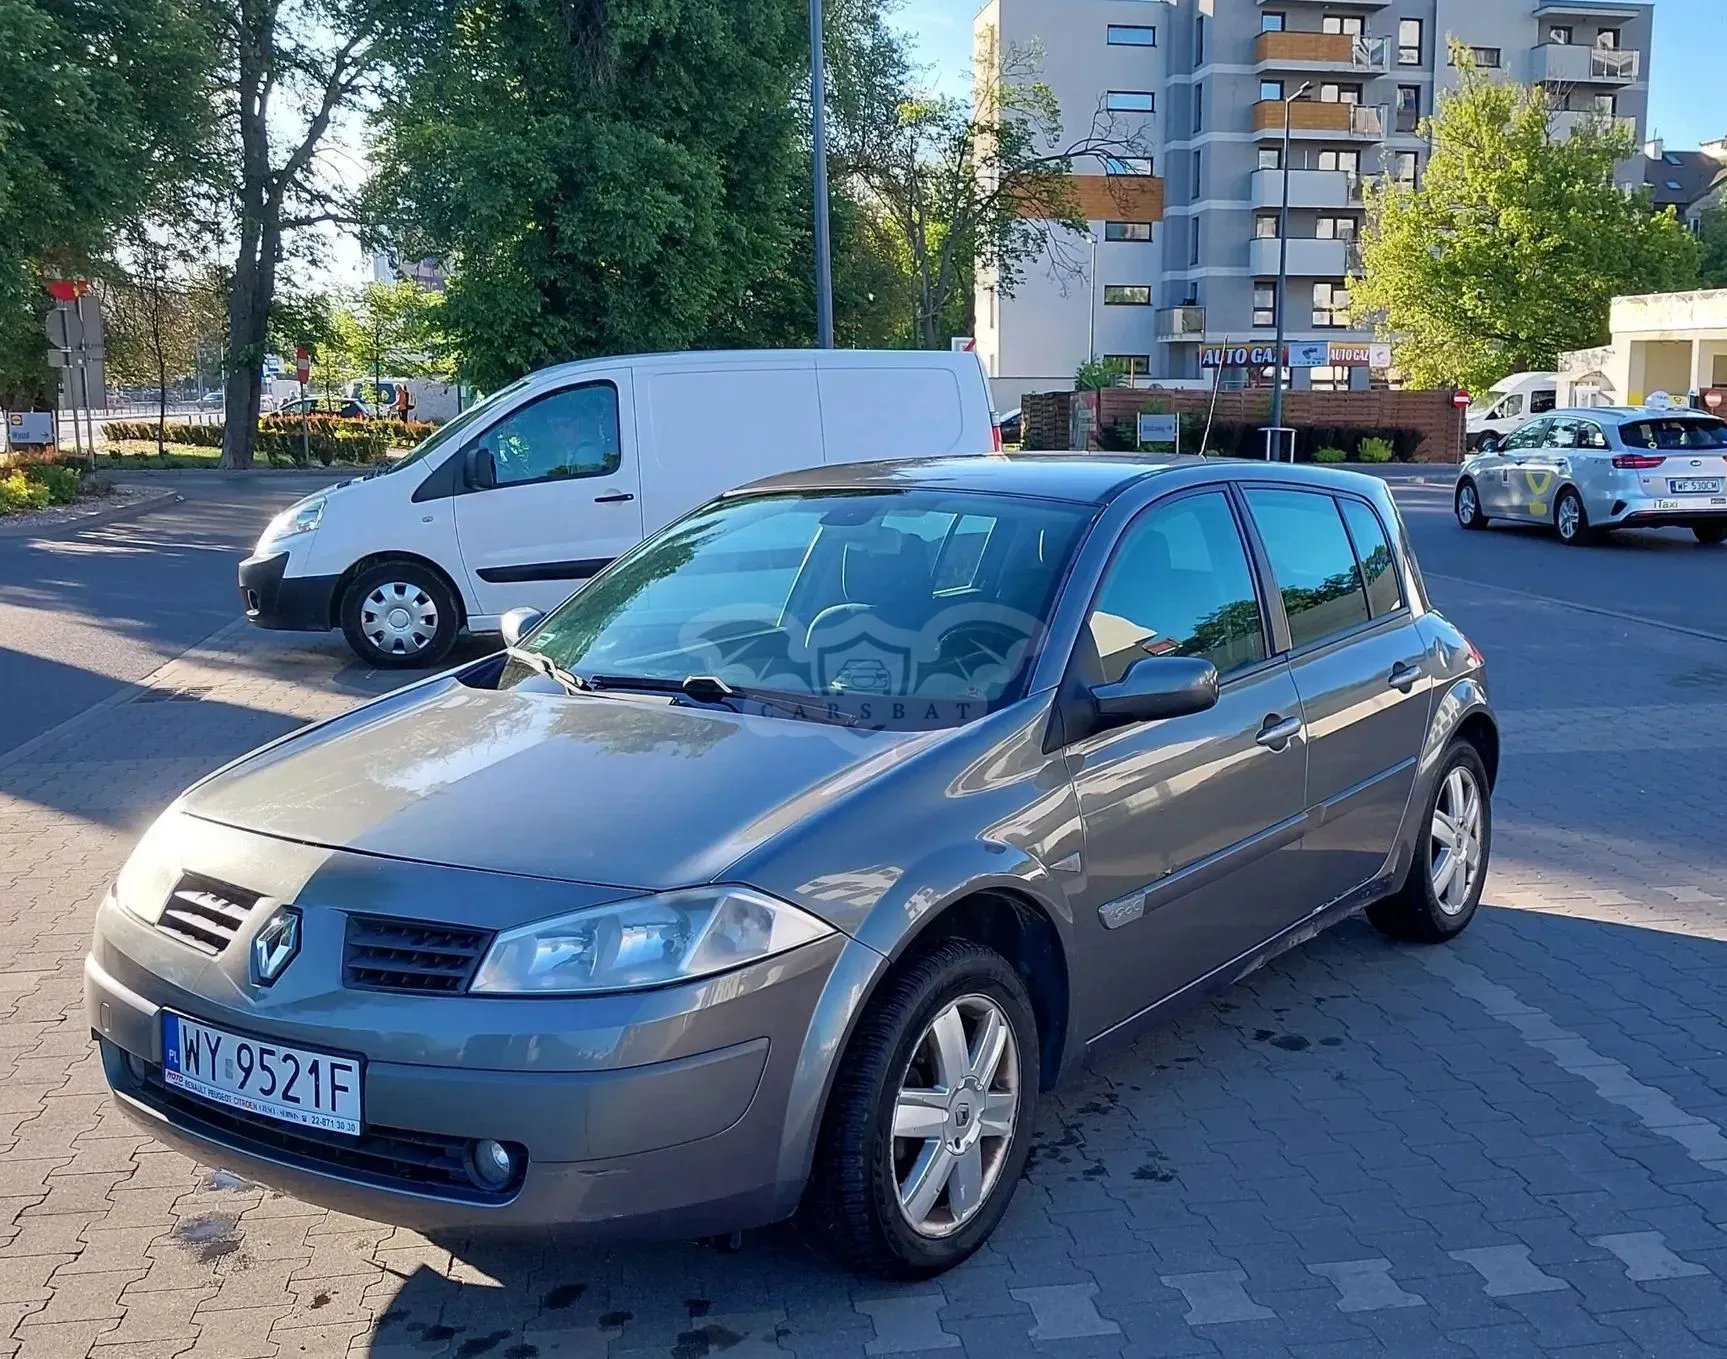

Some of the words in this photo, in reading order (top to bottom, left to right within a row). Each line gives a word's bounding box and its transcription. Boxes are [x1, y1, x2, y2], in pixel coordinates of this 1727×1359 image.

[1202, 346, 1248, 366] AUTO
[1329, 348, 1352, 361] AUTO
[1353, 348, 1370, 361] GAZ
[1653, 498, 1679, 509] iTaxi
[168, 1049, 179, 1065] PL
[182, 1024, 222, 1082] WY
[236, 1042, 353, 1112] 9521F
[166, 1070, 184, 1083] MOTO
[184, 1079, 206, 1095] RENAULT
[207, 1088, 232, 1103] PEUGEOT
[336, 1120, 345, 1130] 30
